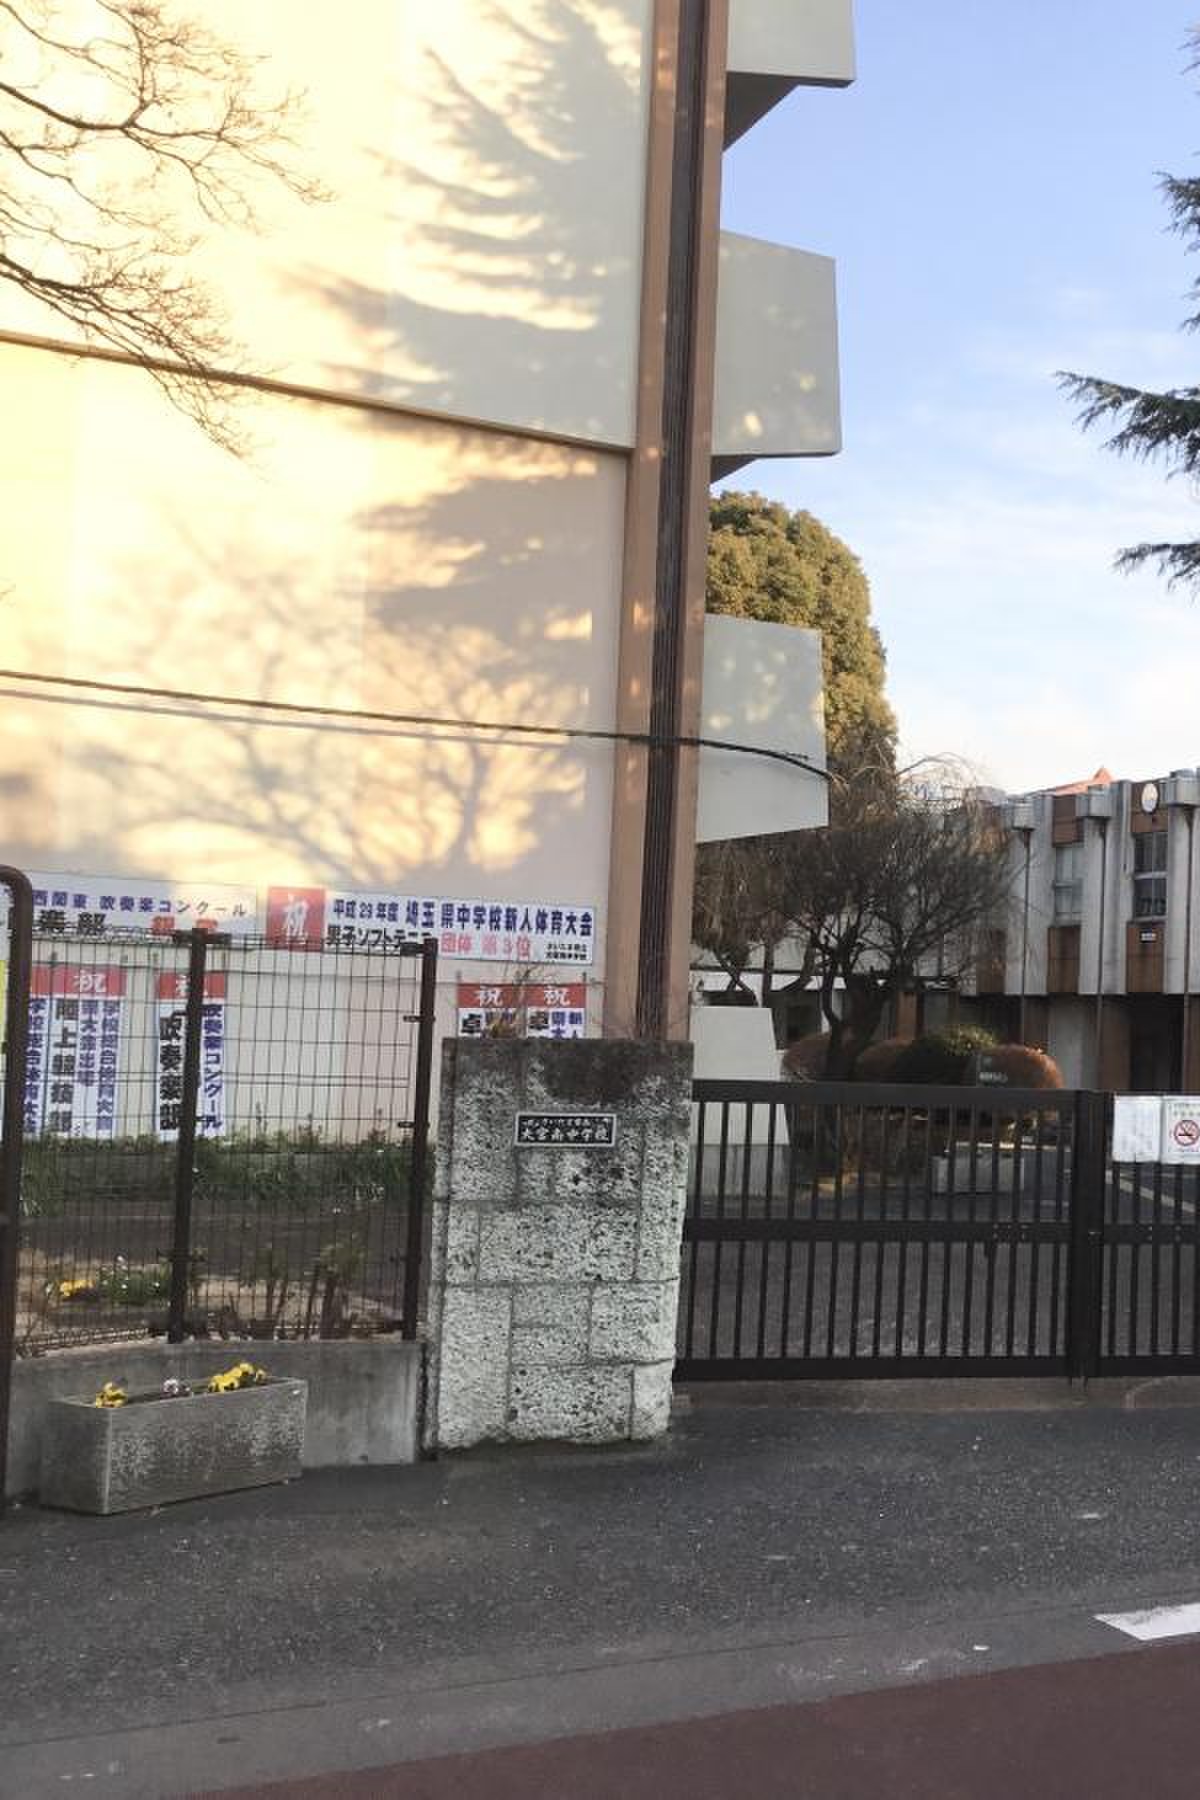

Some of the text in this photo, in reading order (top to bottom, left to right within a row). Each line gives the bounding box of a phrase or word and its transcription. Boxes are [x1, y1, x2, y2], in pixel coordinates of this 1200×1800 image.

[405, 900, 593, 937] 埼玉県中学校新人体育大会
[475, 986, 503, 1007] 祝
[544, 986, 571, 1007] 祝
